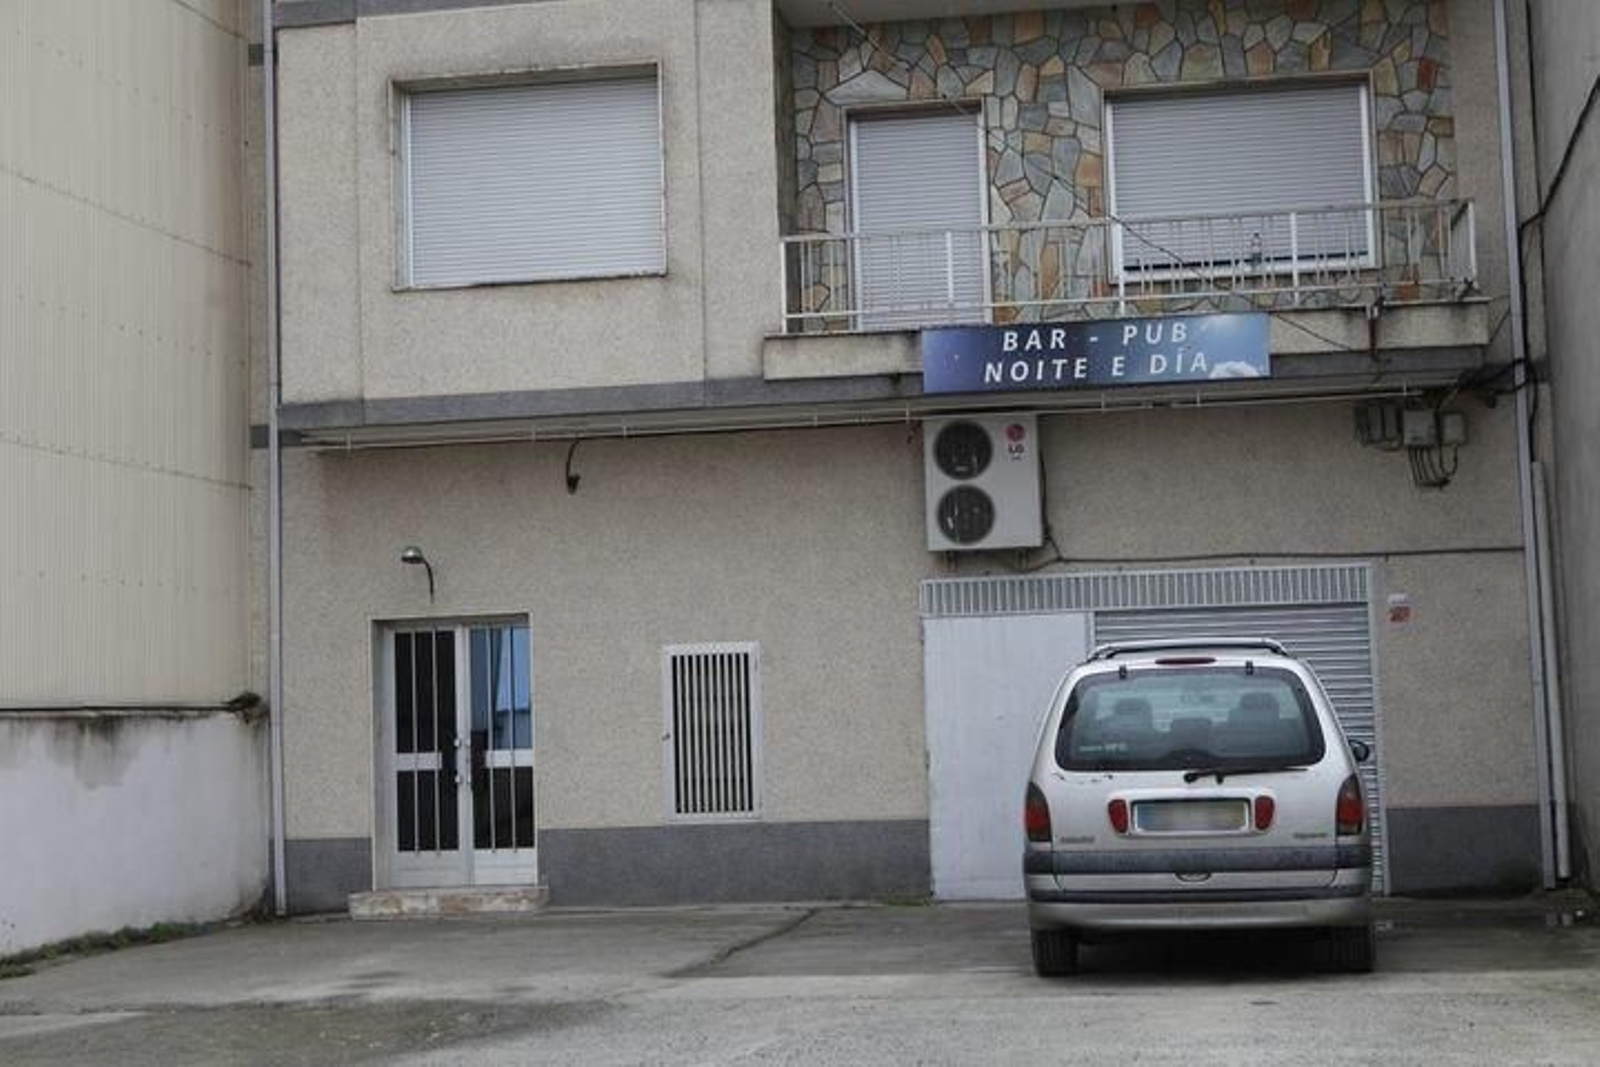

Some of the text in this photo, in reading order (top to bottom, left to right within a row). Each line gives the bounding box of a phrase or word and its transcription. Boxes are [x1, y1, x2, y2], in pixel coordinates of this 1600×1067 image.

[1003, 329, 1066, 351] BAR
[1122, 323, 1187, 345] PUB
[985, 347, 1207, 383] NOITE E DÍA
[1008, 443, 1024, 454] LG
